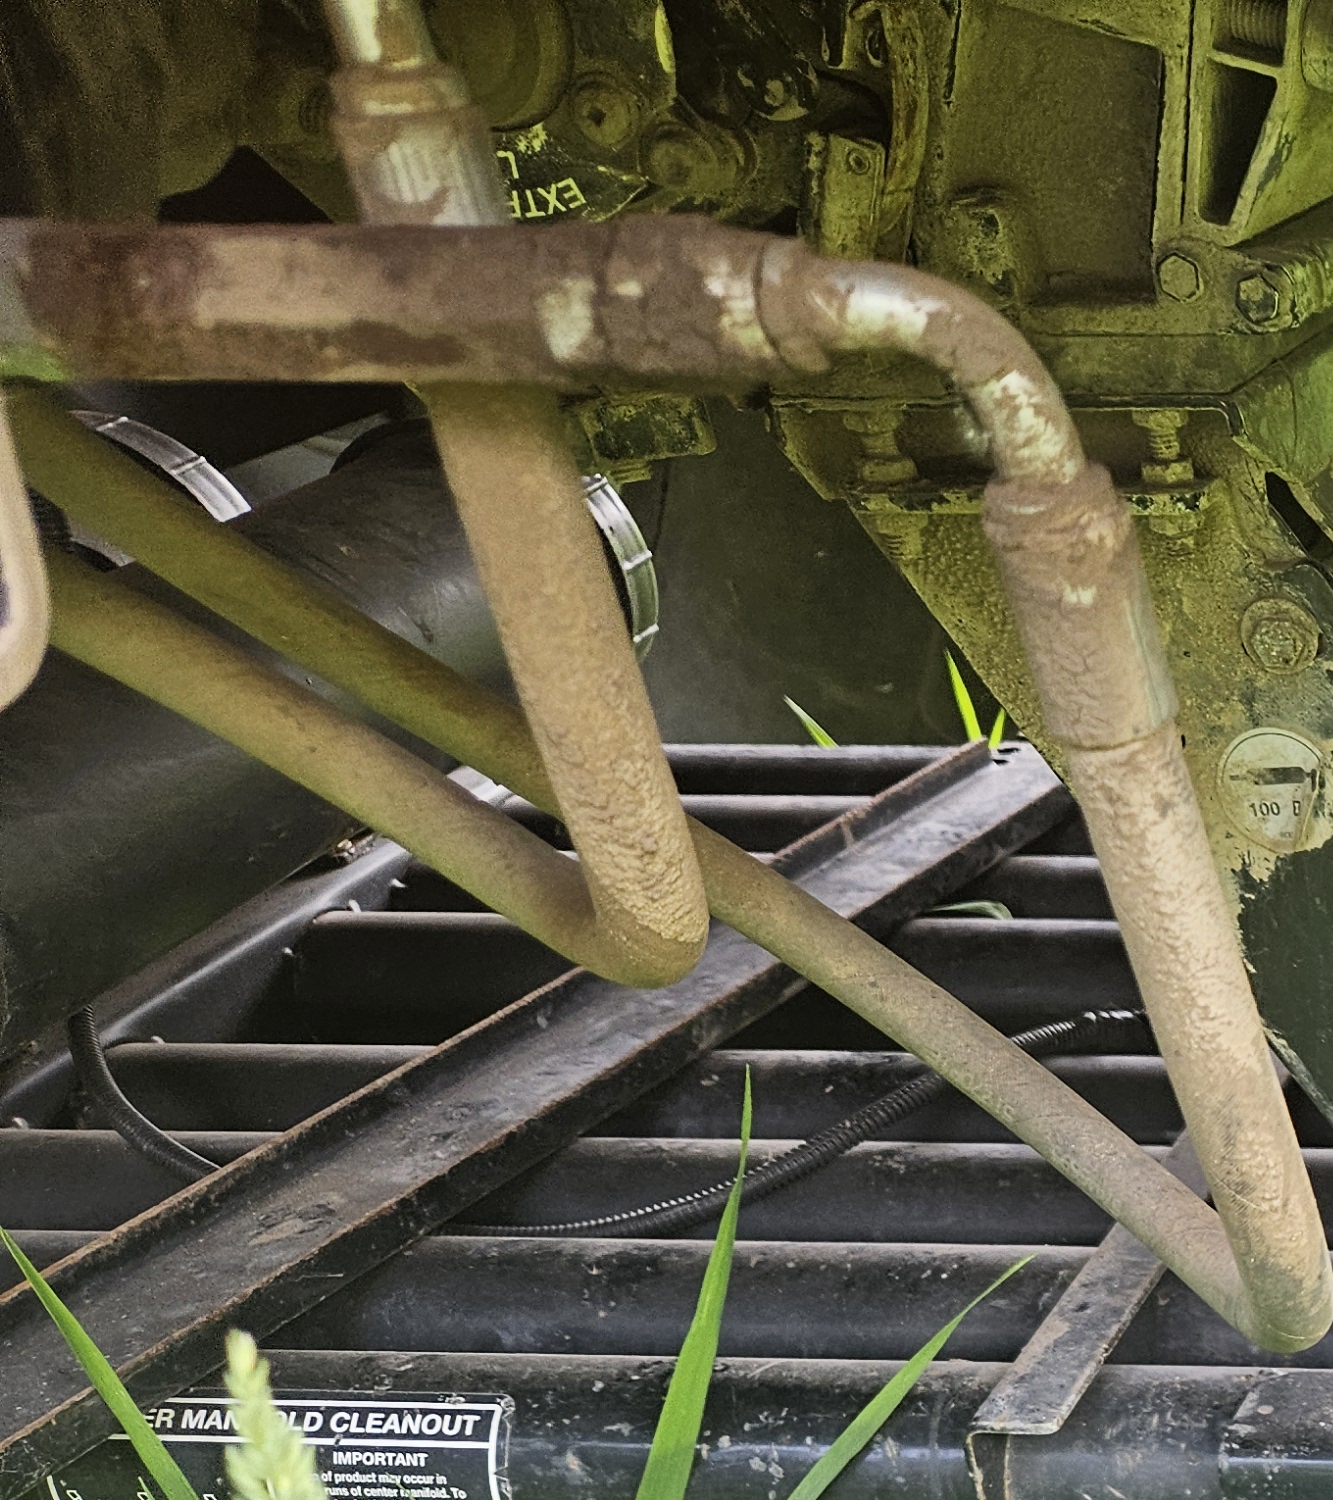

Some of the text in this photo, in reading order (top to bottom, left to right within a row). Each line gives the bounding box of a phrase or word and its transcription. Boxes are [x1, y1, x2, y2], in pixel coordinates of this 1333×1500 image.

[1249, 802, 1280, 817] 100
[329, 1411, 482, 1436] CLEANOUT
[332, 1451, 429, 1467] IMPORTANT
[321, 1470, 332, 1482] of
[334, 1471, 377, 1485] product
[403, 1474, 435, 1484] occur
[436, 1472, 448, 1485] in
[350, 1485, 362, 1497] of
[363, 1486, 398, 1498] center
[450, 1487, 467, 1500] To
